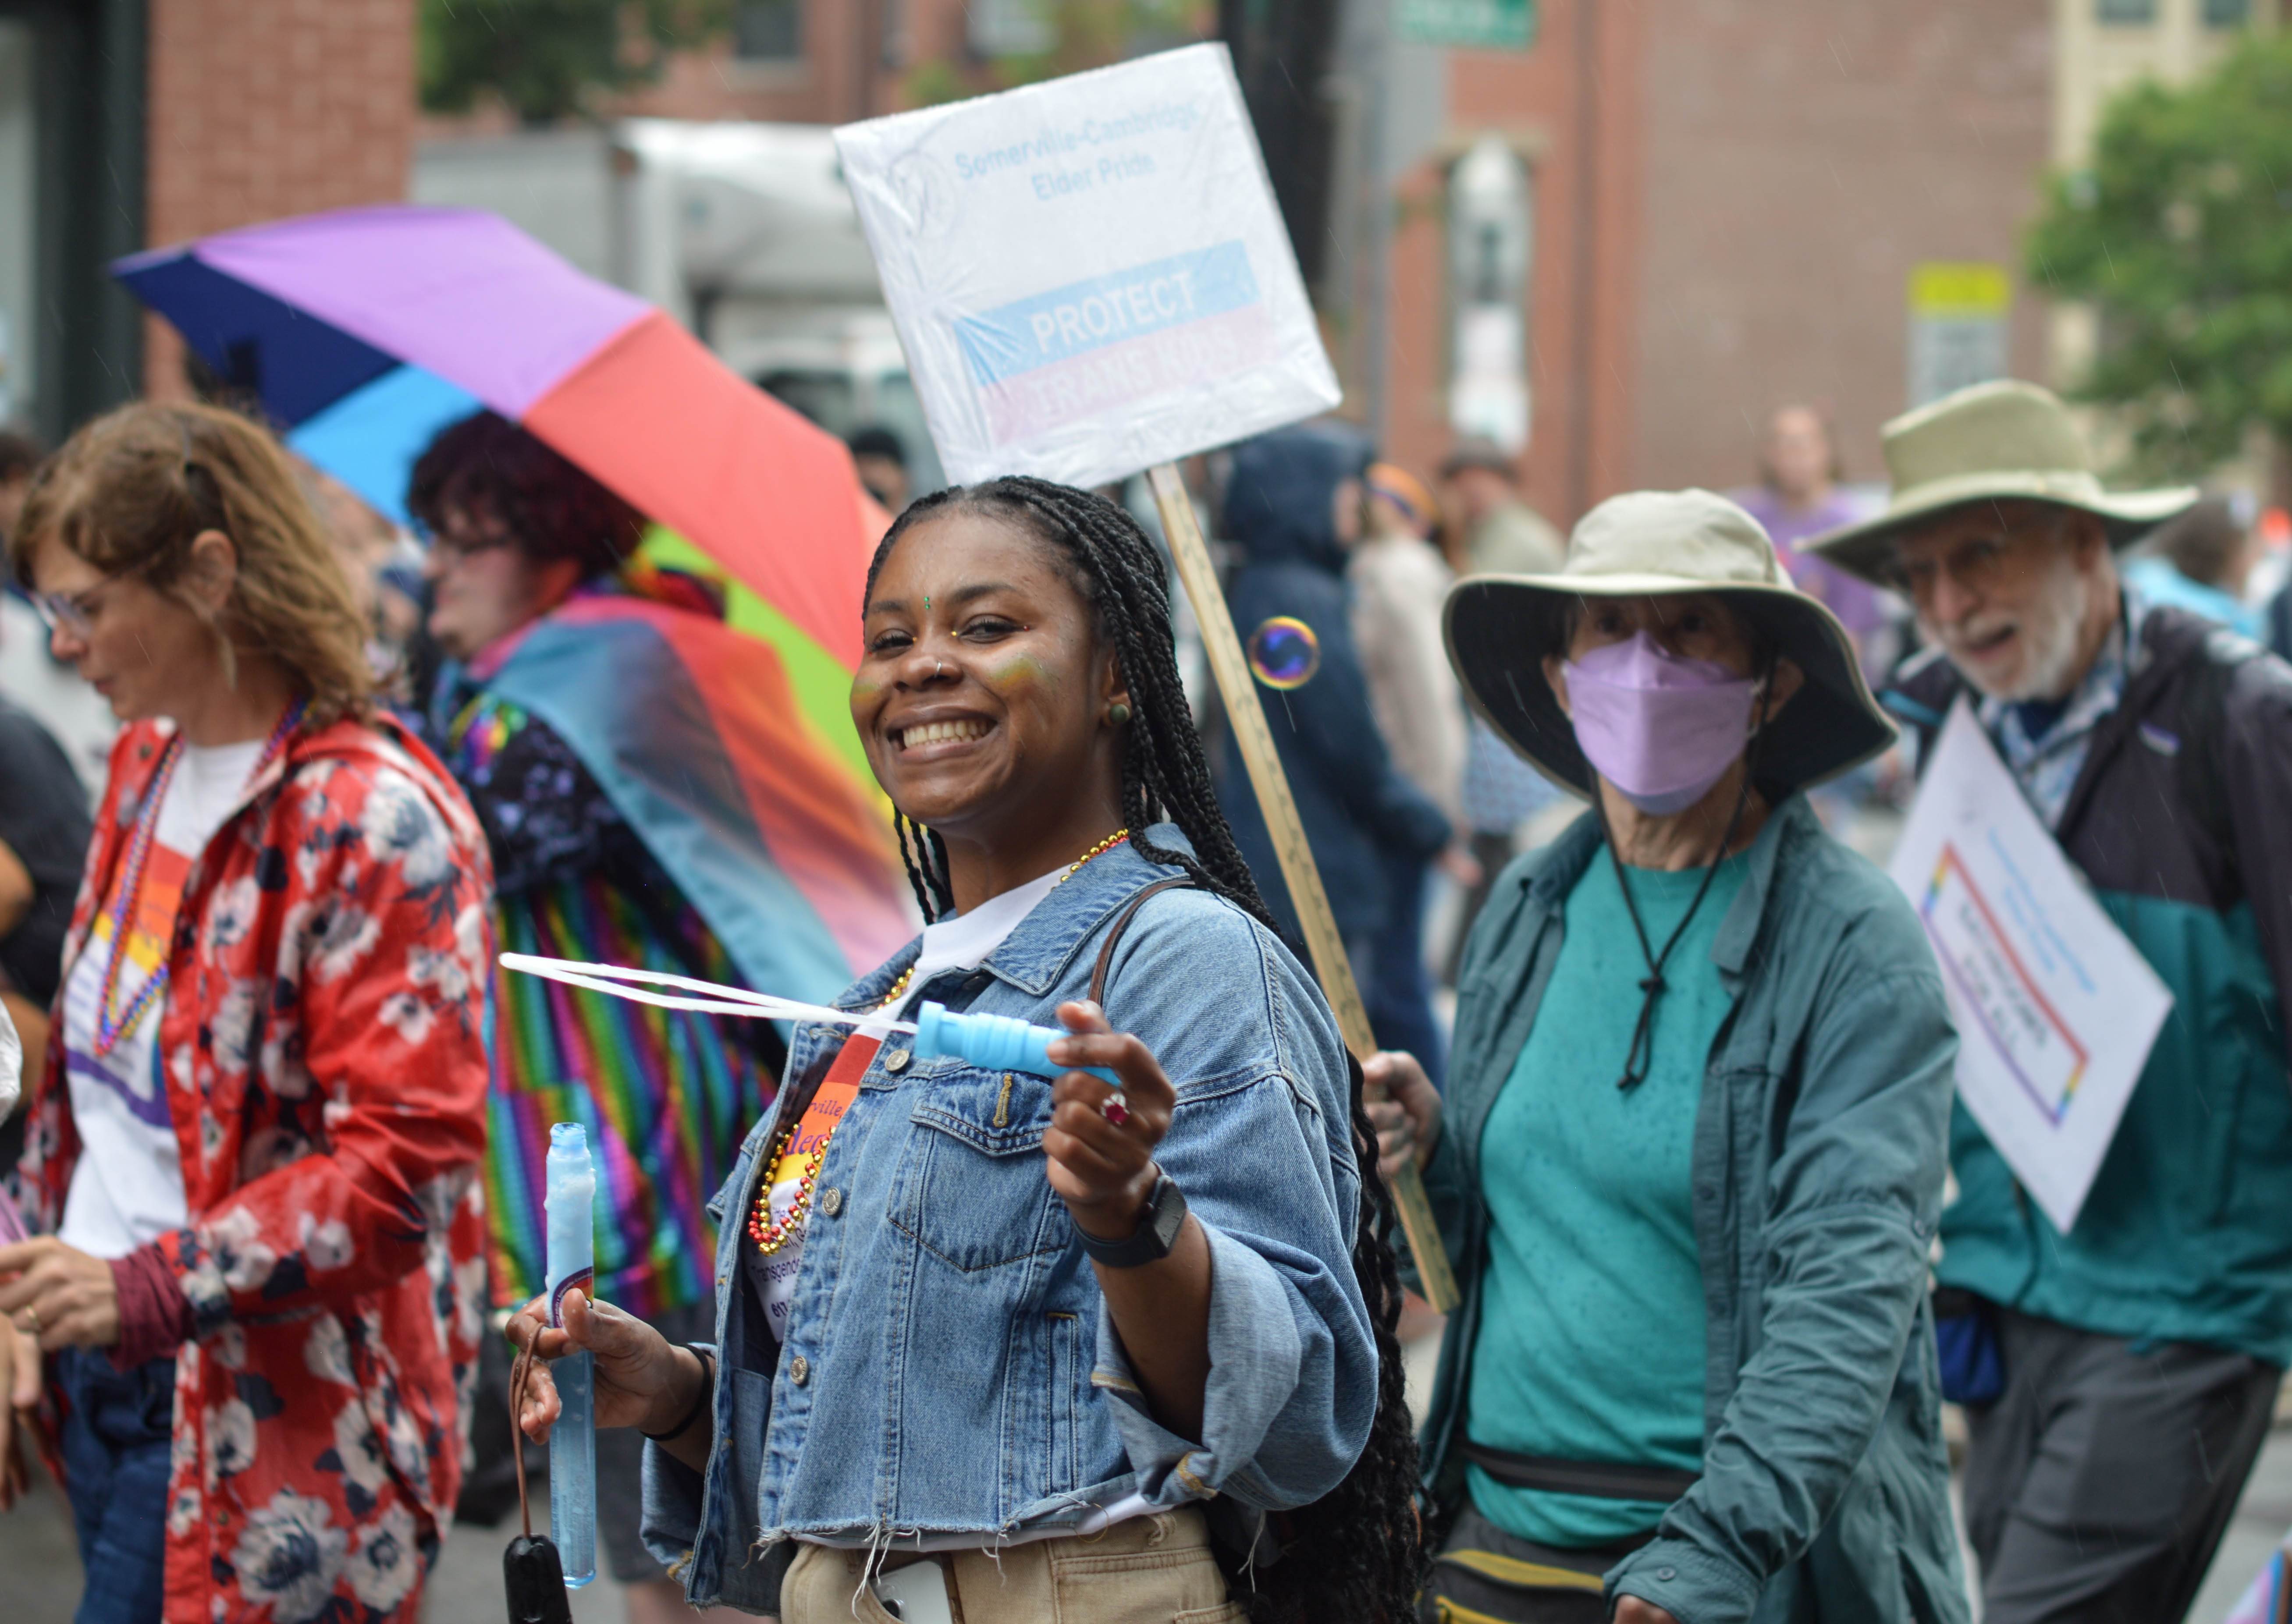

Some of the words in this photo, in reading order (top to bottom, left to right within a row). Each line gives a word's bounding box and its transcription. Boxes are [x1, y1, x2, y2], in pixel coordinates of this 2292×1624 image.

[954, 100, 1201, 181] Somerville-Cambridge
[1031, 167, 1094, 201] Elder
[1098, 151, 1157, 184] Pride
[1030, 270, 1196, 353] PROTECT
[1027, 347, 1154, 418] TRANS
[1155, 324, 1240, 377] KIDS
